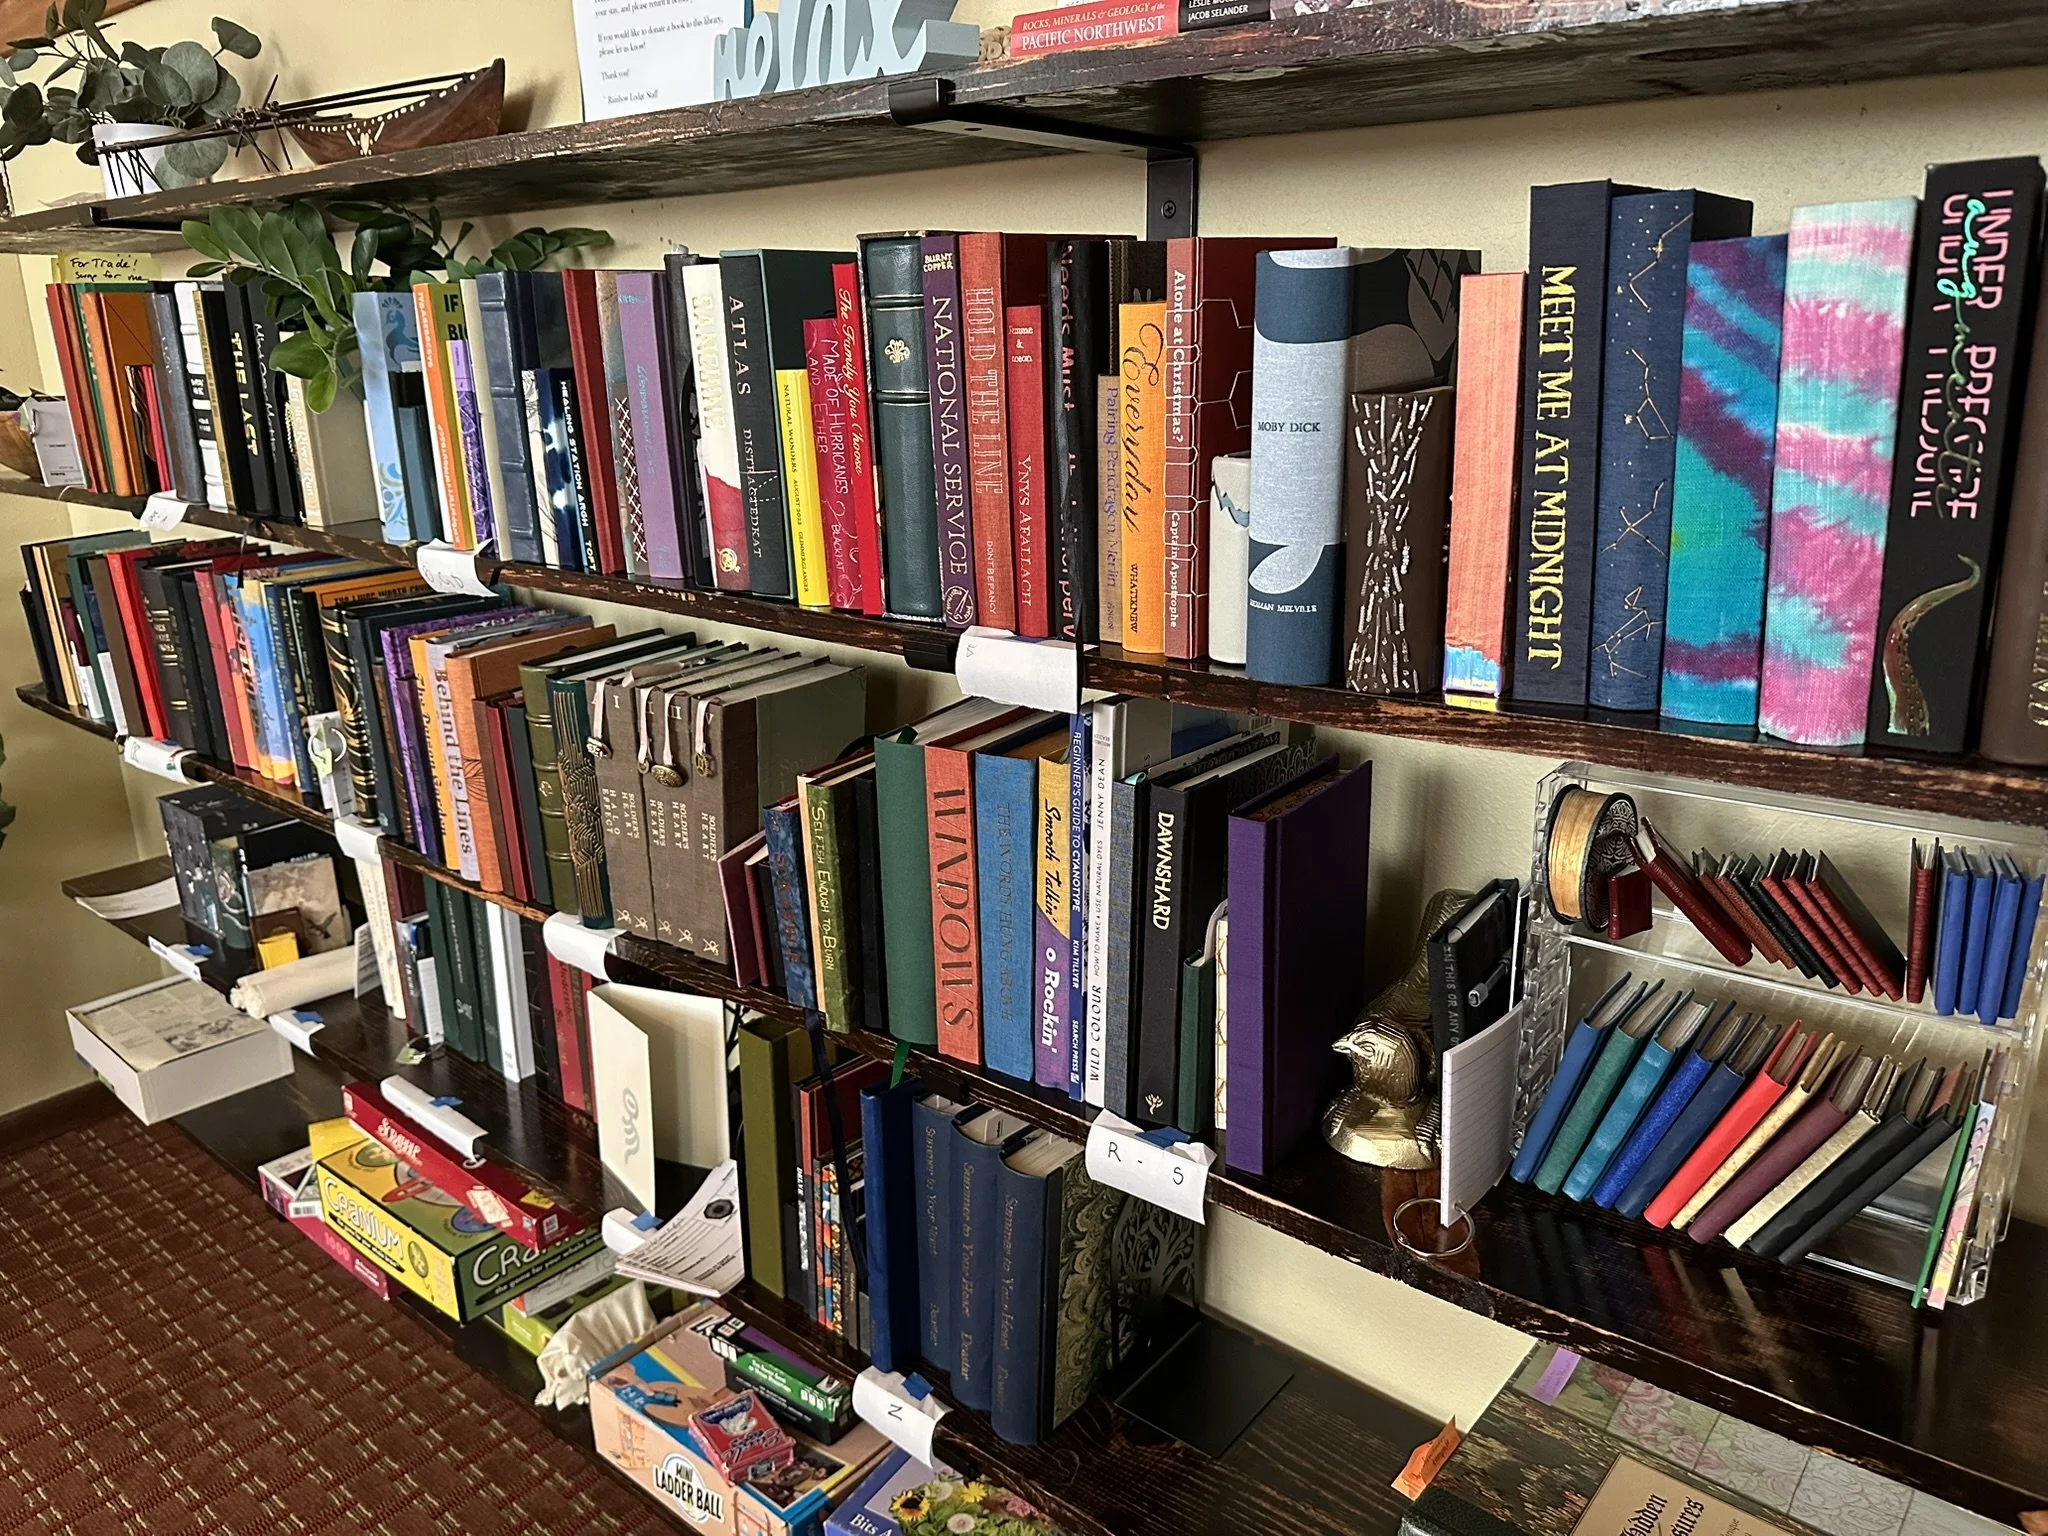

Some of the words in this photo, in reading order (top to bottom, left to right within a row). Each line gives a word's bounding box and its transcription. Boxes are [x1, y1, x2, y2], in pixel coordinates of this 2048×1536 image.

[1022, 18, 1051, 31] ROCKS,
[1053, 11, 1096, 27] MINERALS
[1107, 4, 1149, 18] GEOLOGY
[1022, 27, 1072, 50] PACIFIC
[1074, 14, 1165, 42] NORTHWEST
[1188, 11, 1211, 23] JACOB
[1211, 4, 1249, 20] SELANDER
[70, 258, 89, 268] For
[103, 270, 121, 280] for
[923, 260, 953, 272] COPPER
[924, 252, 953, 263] BURNT
[444, 294, 459, 313] IF
[839, 287, 852, 321] The
[1061, 244, 1073, 337] Needs
[1174, 269, 1186, 324] Alone
[1539, 265, 1577, 362] MEET
[965, 287, 996, 361] HOLD
[1174, 327, 1184, 345] at
[231, 332, 248, 385] THE
[809, 357, 821, 387] AND
[820, 338, 837, 382] MADE
[841, 322, 857, 382] Family
[826, 384, 839, 408] OF
[844, 381, 859, 420] You
[932, 297, 958, 458] NATIONAL
[970, 369, 1000, 425] THE
[1061, 346, 1074, 412] Must
[1172, 348, 1185, 442] Christmas?
[1536, 370, 1573, 422] ME
[239, 392, 258, 456] LAST
[729, 296, 751, 396] ATLAS
[743, 428, 762, 558] DISTRACTEDKAT
[814, 404, 828, 454] ETHER
[1102, 387, 1119, 445] Pairing
[1122, 322, 1163, 534] Everyday
[1257, 420, 1285, 434] MOBY
[1289, 420, 1321, 433] DICK
[782, 384, 793, 427] NATURAL
[788, 429, 797, 473] WONDERS
[793, 479, 801, 507] AUGUST
[828, 412, 849, 495] HURRICANES
[849, 421, 863, 476] Choose
[970, 438, 1003, 496] LINE
[1534, 432, 1570, 485] AT
[560, 381, 575, 435] HEALING
[568, 438, 584, 490] STATION
[577, 493, 589, 527] ARGH
[584, 540, 597, 572] TOFT
[1018, 455, 1031, 507] YNYS
[943, 463, 968, 575] SERVICE
[1171, 512, 1181, 561] Captain
[985, 541, 997, 616] DONTBEFANCY
[1019, 510, 1033, 607] AFALLACH
[1527, 490, 1567, 670] MIDNIGHT
[1169, 563, 1180, 628] Apostrophe
[1277, 604, 1317, 612] MELVILLE
[436, 669, 459, 744] Behind
[447, 750, 463, 789] the
[1072, 731, 1082, 796] BEGINNER'S
[456, 797, 472, 854] Lines
[602, 788, 614, 834] EFFECT
[609, 789, 621, 835] HALO
[621, 791, 634, 838] HEART
[628, 792, 640, 839] SOLDIER'S
[650, 799, 660, 845] HEART
[656, 801, 667, 847] SOLDIER'S
[672, 801, 682, 848] HEART
[680, 802, 690, 850] SOLDIER'S
[812, 806, 826, 864] SELFISH
[997, 802, 1012, 837] THE
[1045, 798, 1061, 863] Smooth
[1072, 798, 1081, 832] GUIDE
[1097, 795, 1105, 829] JENNY
[701, 812, 710, 860] HEART
[708, 815, 718, 862] SOLDIER'S
[1072, 834, 1081, 848] TO
[818, 870, 831, 913] ENOUGH
[1071, 850, 1081, 912] CYANOTYPE
[1152, 811, 1175, 930] DAWNSHARD
[933, 788, 974, 1034] WINDOWS
[1044, 869, 1062, 922] Talkin'
[1000, 910, 1013, 962] HUNG
[1072, 939, 1080, 955] KIM
[1096, 943, 1101, 954] TO
[1072, 956, 1080, 989] TILLYER
[1444, 963, 1456, 988] THIS
[1042, 967, 1060, 1054] Rockin'
[1090, 985, 1102, 1042] COLOUR
[1447, 993, 1457, 1007] OR
[1447, 1009, 1458, 1033] ANY
[1071, 1049, 1079, 1071] PRESS
[1089, 1048, 1101, 1082] WILD
[1108, 1142, 1121, 1162] R
[1173, 1167, 1184, 1185] S
[963, 1161, 975, 1220] Summer
[963, 1223, 973, 1236] to
[1004, 1193, 1018, 1254] Summer
[962, 1242, 974, 1275] Your
[1002, 1256, 1012, 1271] to
[655, 1467, 694, 1506] LADDER
[696, 1487, 721, 1520] BALL
[676, 1462, 693, 1483] MINI
[850, 1513, 879, 1536] Bits
